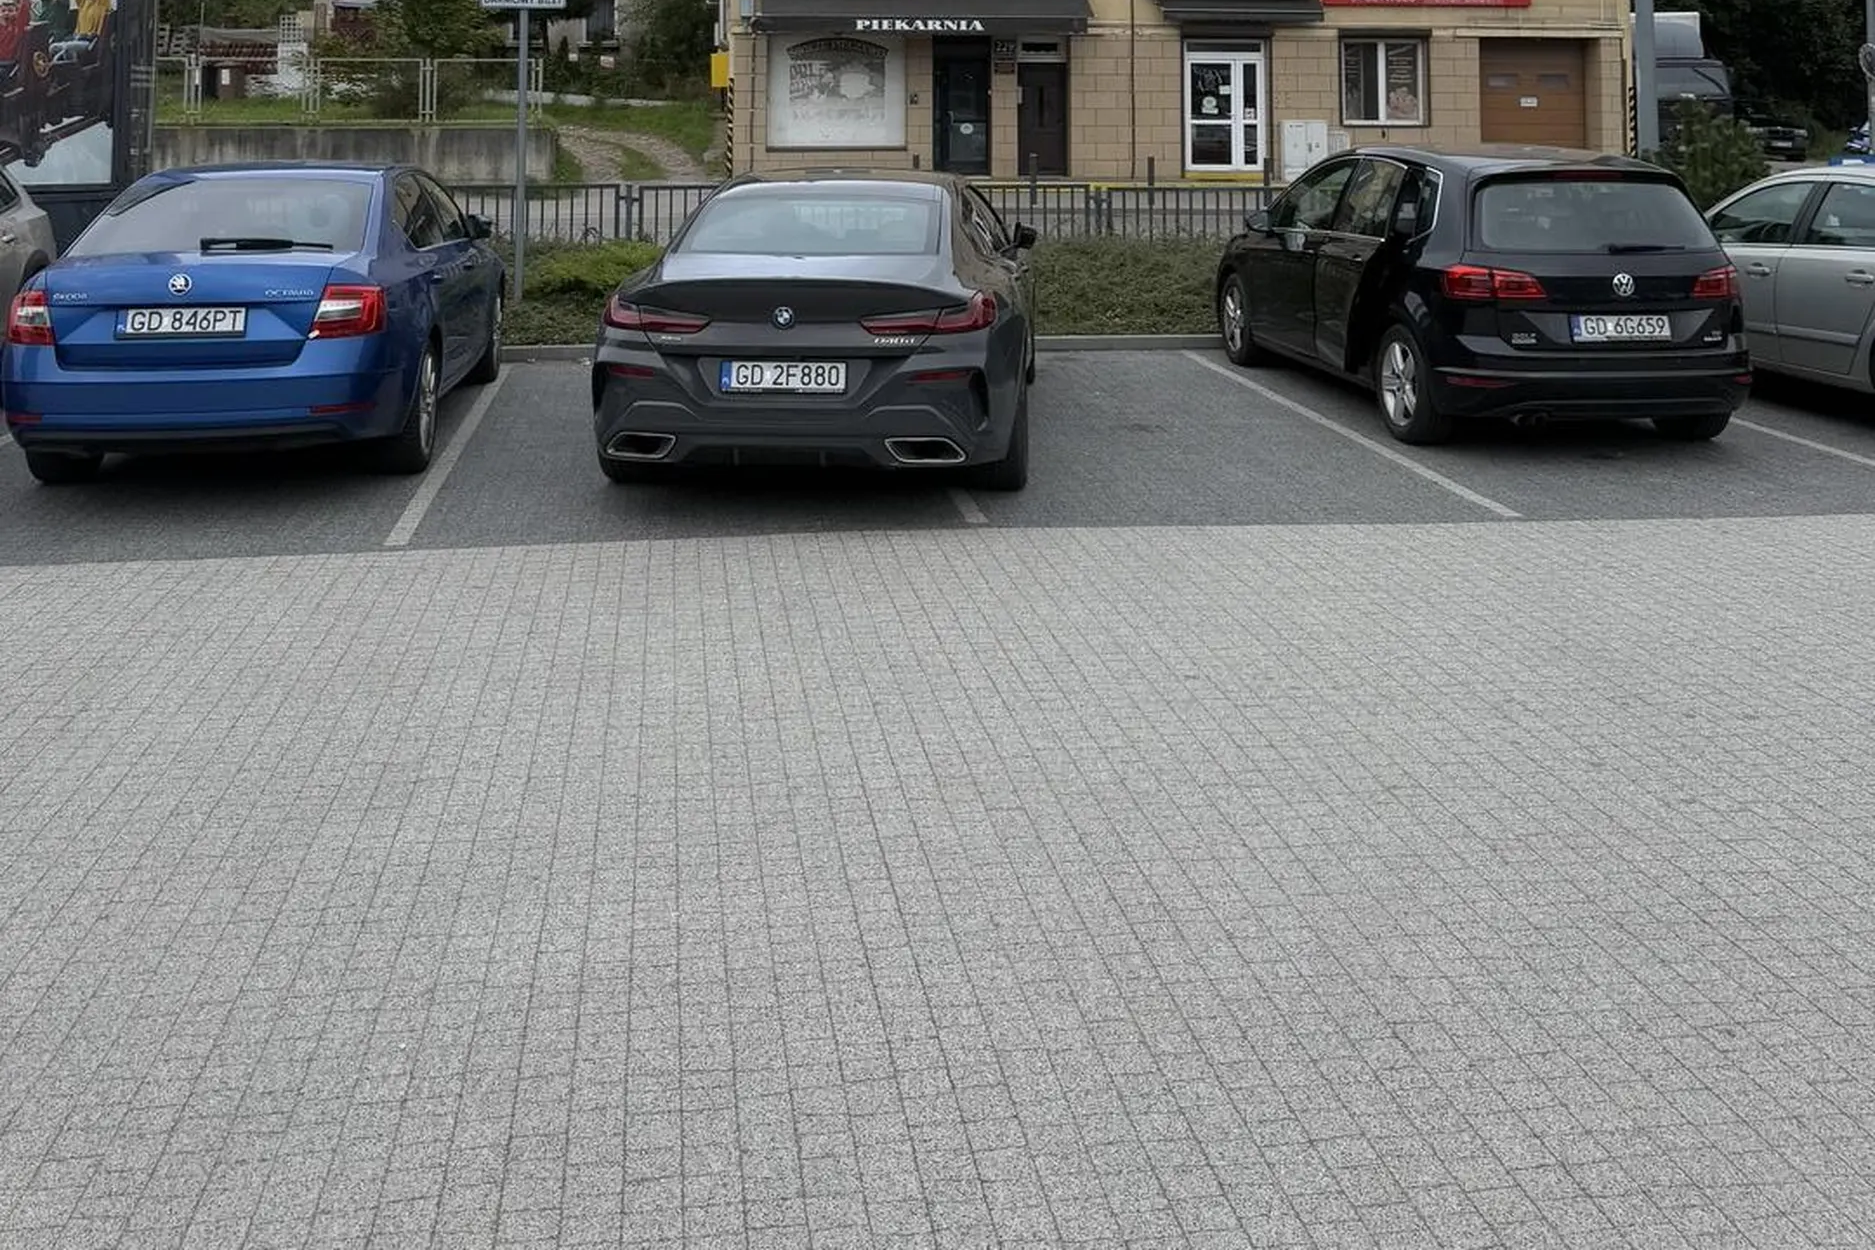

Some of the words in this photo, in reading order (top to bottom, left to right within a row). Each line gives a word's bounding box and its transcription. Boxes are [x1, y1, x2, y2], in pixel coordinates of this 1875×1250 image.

[856, 19, 985, 31] PIEKARNIA
[131, 311, 163, 331] GD
[171, 310, 242, 331] 846PT
[1584, 317, 1607, 335] GD
[1614, 317, 1666, 334] 6G659
[736, 364, 764, 386] GD
[772, 364, 840, 386] 2F880
